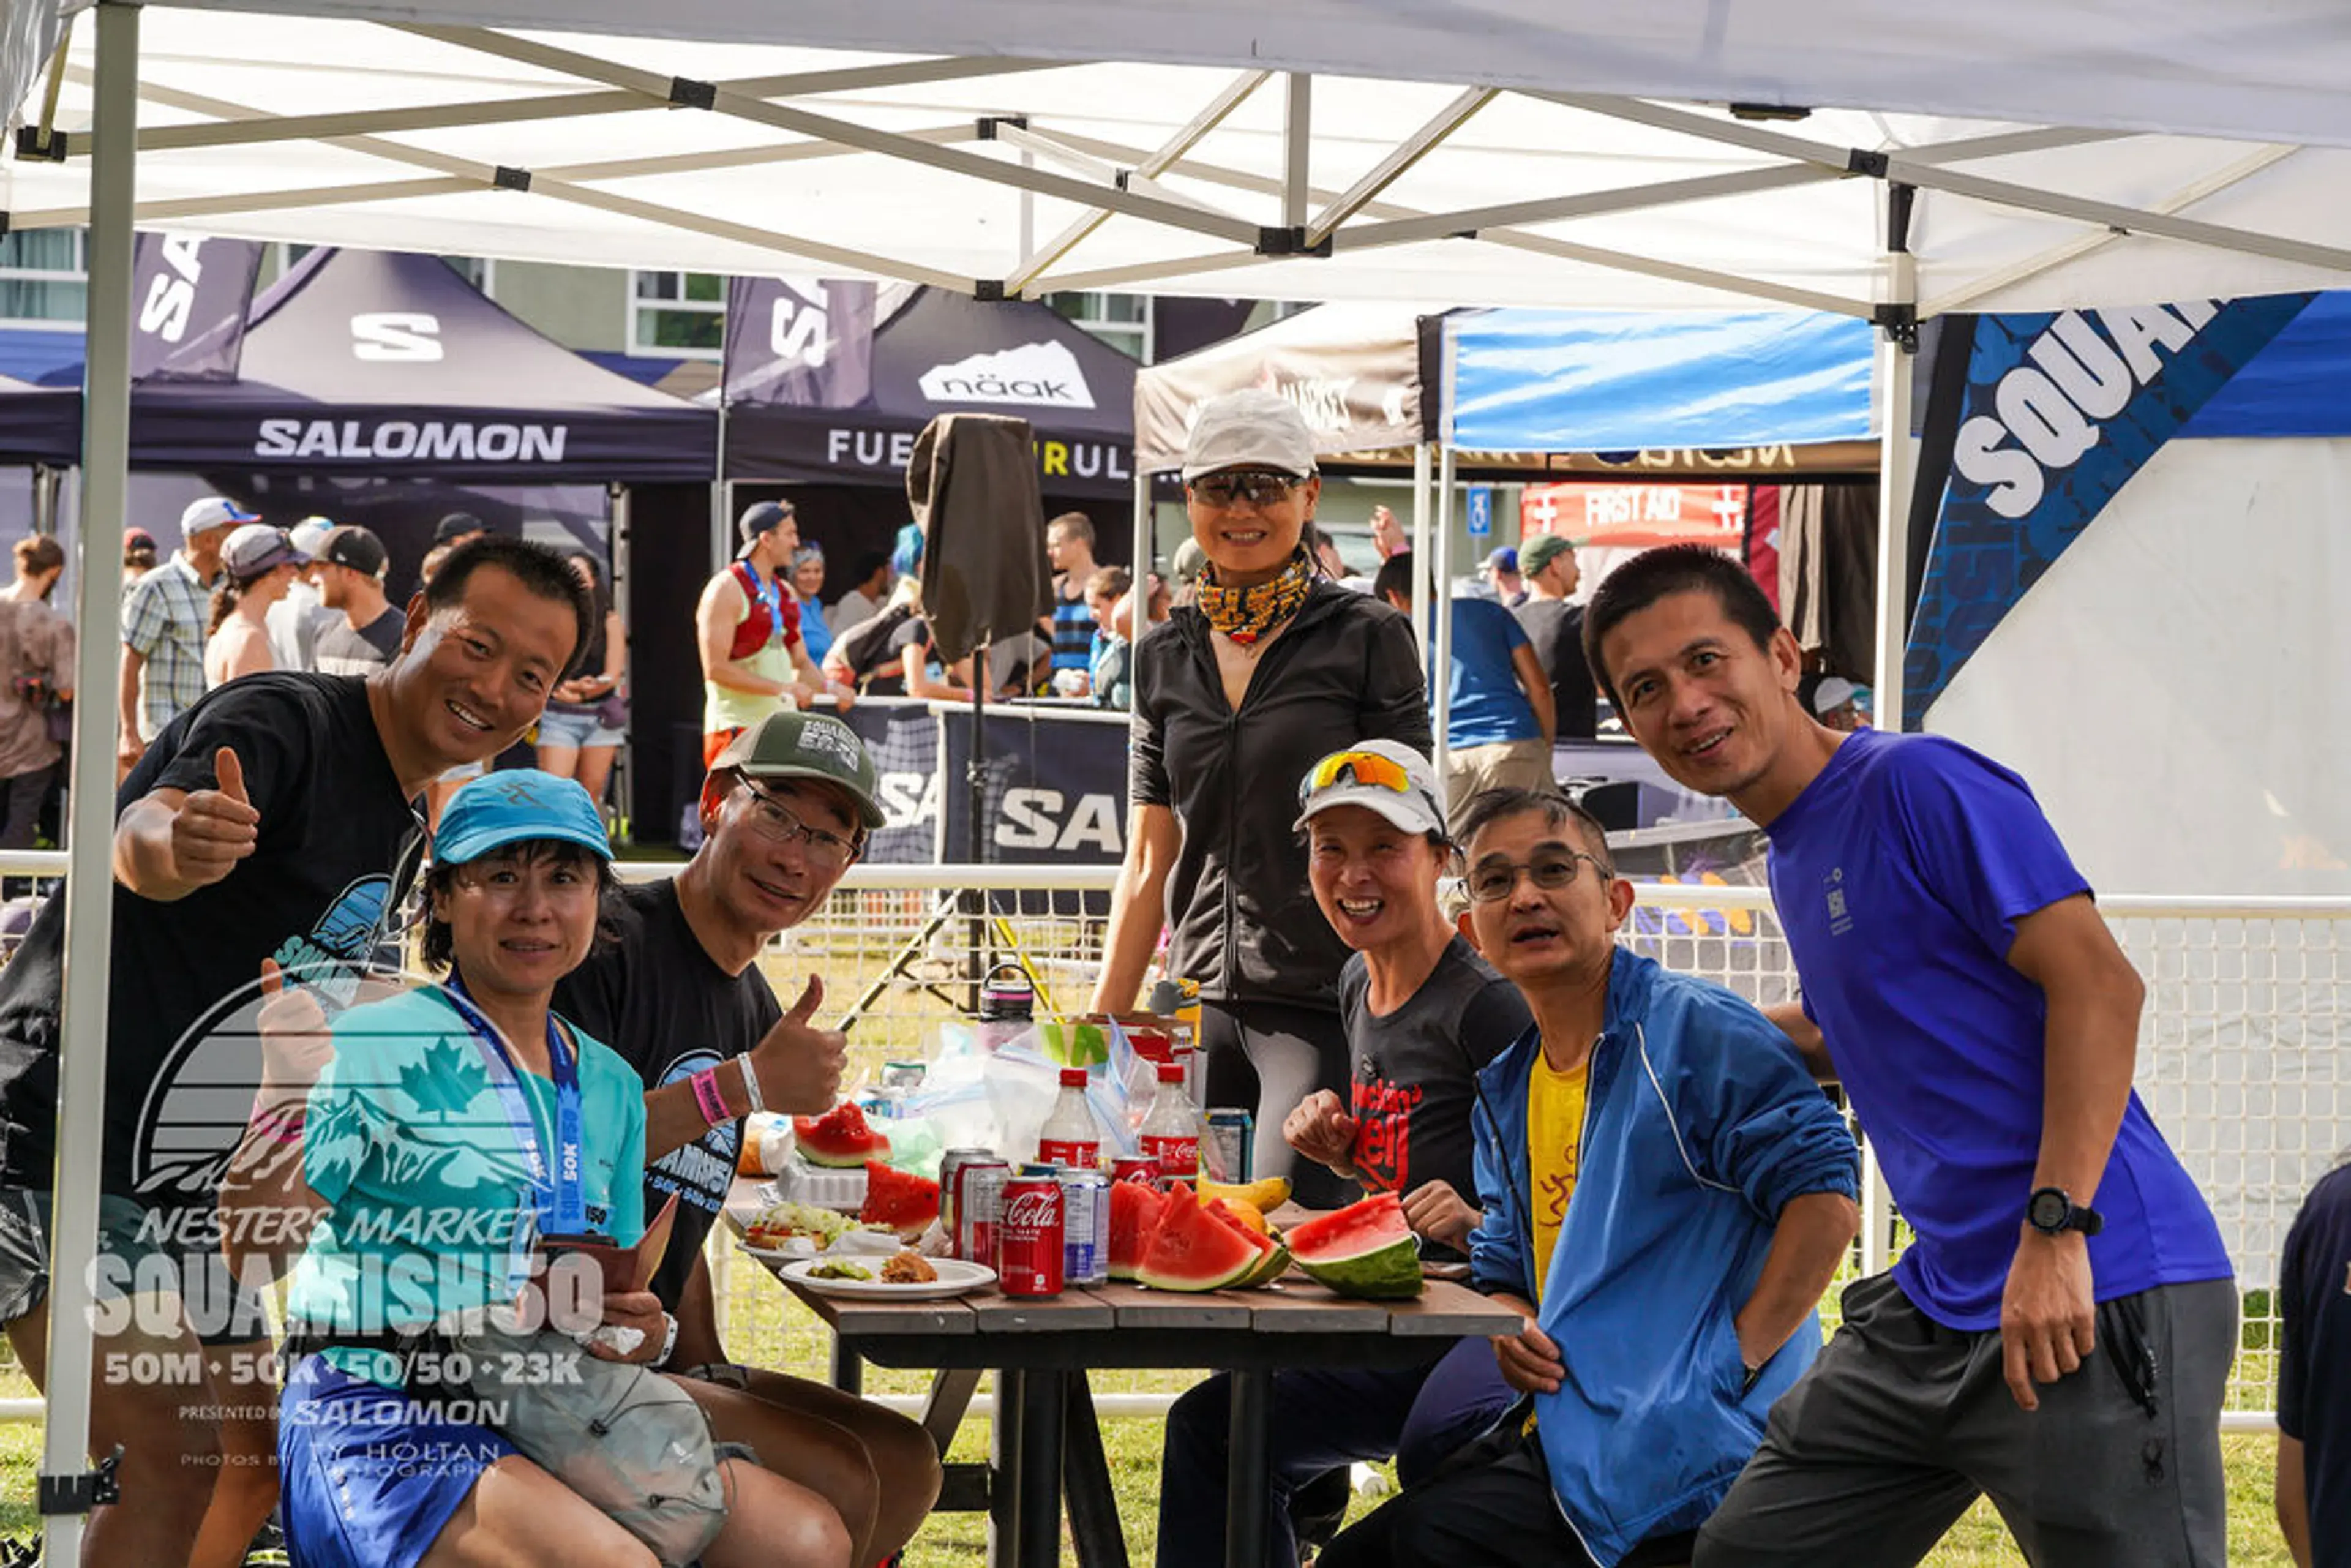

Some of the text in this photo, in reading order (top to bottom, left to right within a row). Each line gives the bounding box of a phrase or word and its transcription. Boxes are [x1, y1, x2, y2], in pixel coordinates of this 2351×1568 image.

[941, 373, 1076, 401] näak
[255, 419, 568, 461] SALOMON
[828, 429, 917, 467] FUE
[1585, 487, 1681, 527] FIRST AID
[1008, 1190, 1060, 1228] Cola
